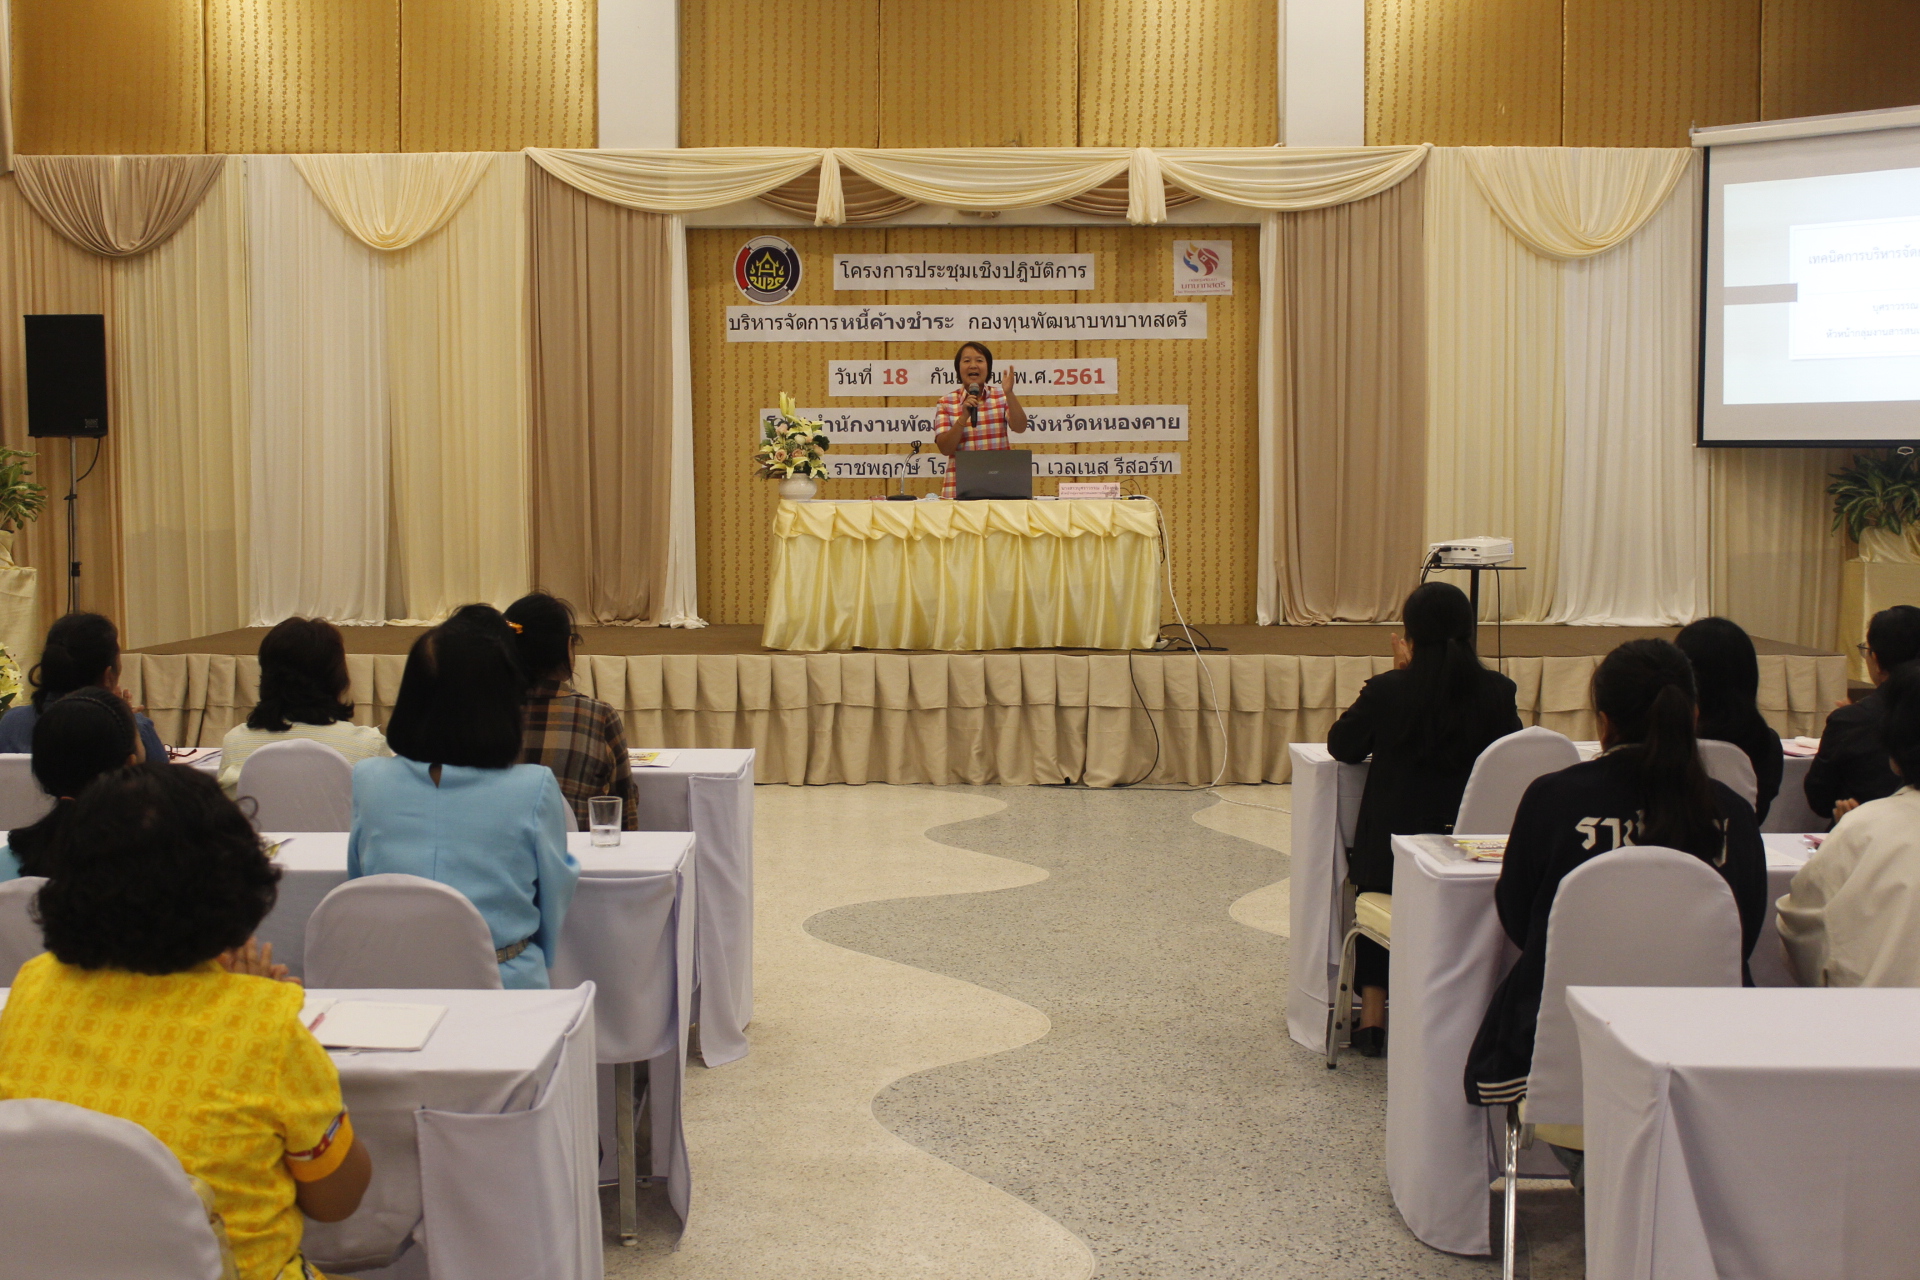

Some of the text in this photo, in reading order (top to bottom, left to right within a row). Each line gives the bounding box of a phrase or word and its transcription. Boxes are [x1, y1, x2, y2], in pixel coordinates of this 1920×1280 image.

[968, 309, 1189, 333] กองทุนพัฒนาบทบาทสตรี
[834, 363, 873, 385] วันที่
[882, 368, 909, 385] 18
[1047, 460, 1109, 475] เวลเนส
[1113, 457, 1173, 475] รีสอร์ท
